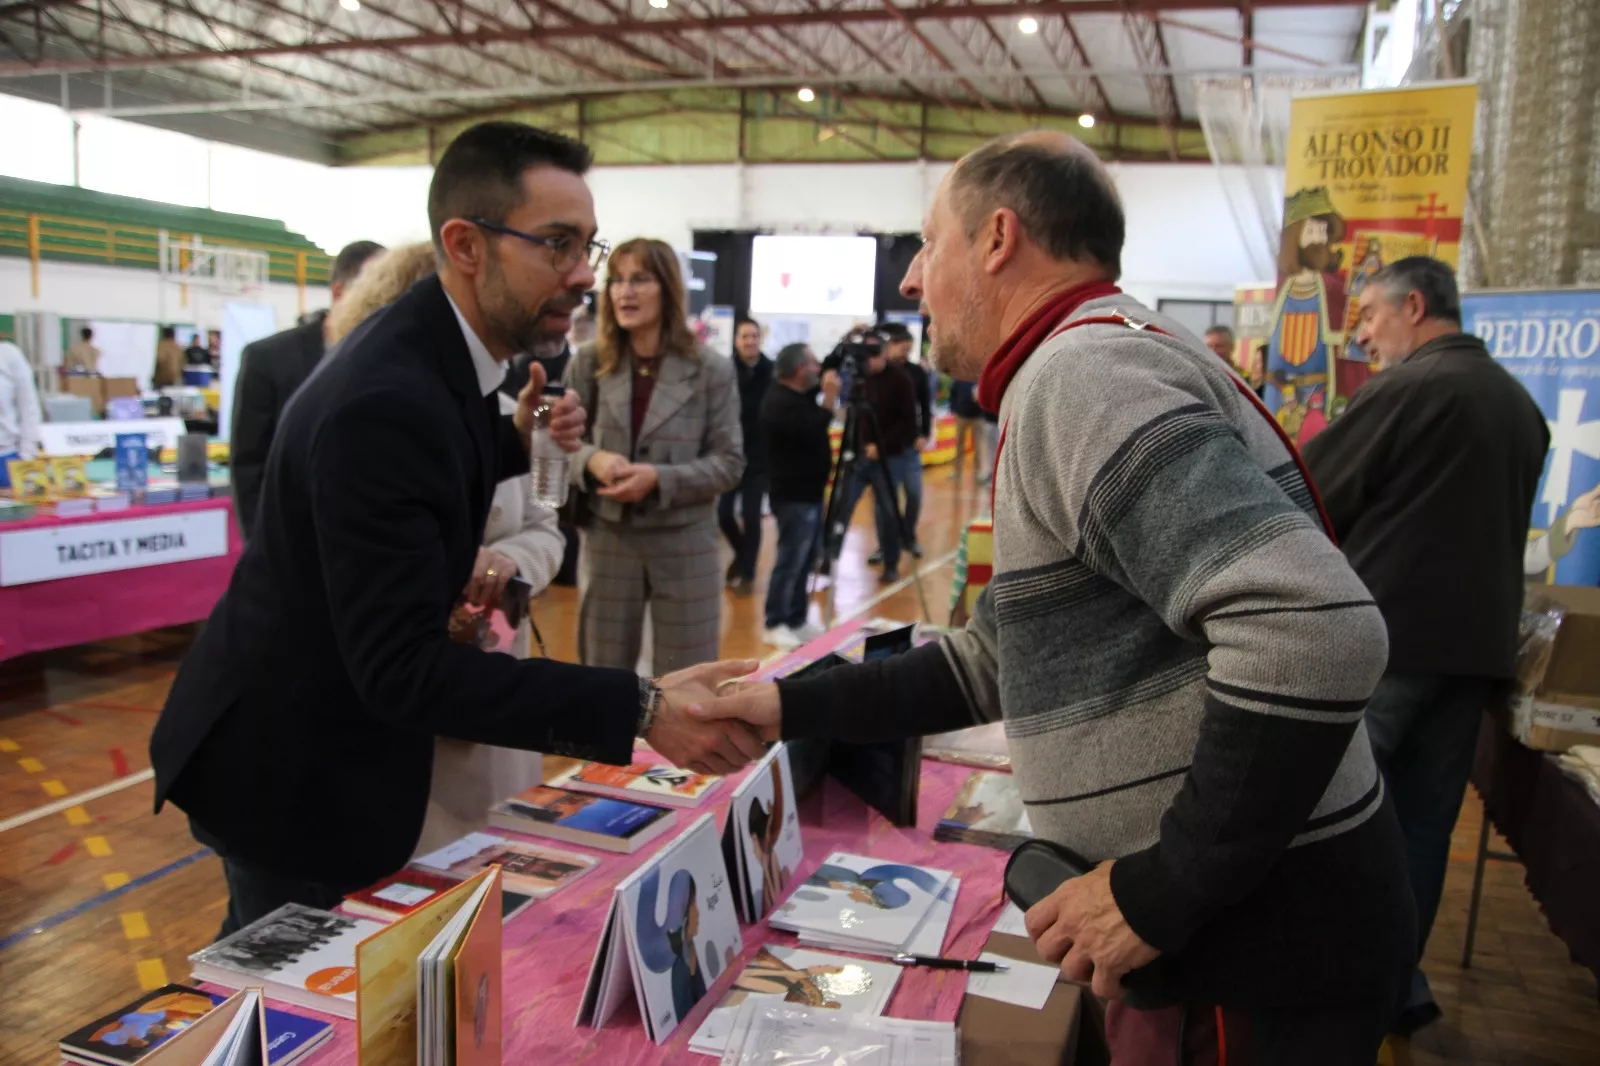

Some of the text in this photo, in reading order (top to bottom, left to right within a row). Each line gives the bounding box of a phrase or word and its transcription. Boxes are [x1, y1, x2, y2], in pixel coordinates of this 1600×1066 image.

[1303, 126, 1450, 158] ALFONSO II
[1319, 152, 1450, 181] TROVADOR
[1474, 317, 1600, 360] PEDRO
[57, 532, 187, 564] TACITA Y MEDIA
